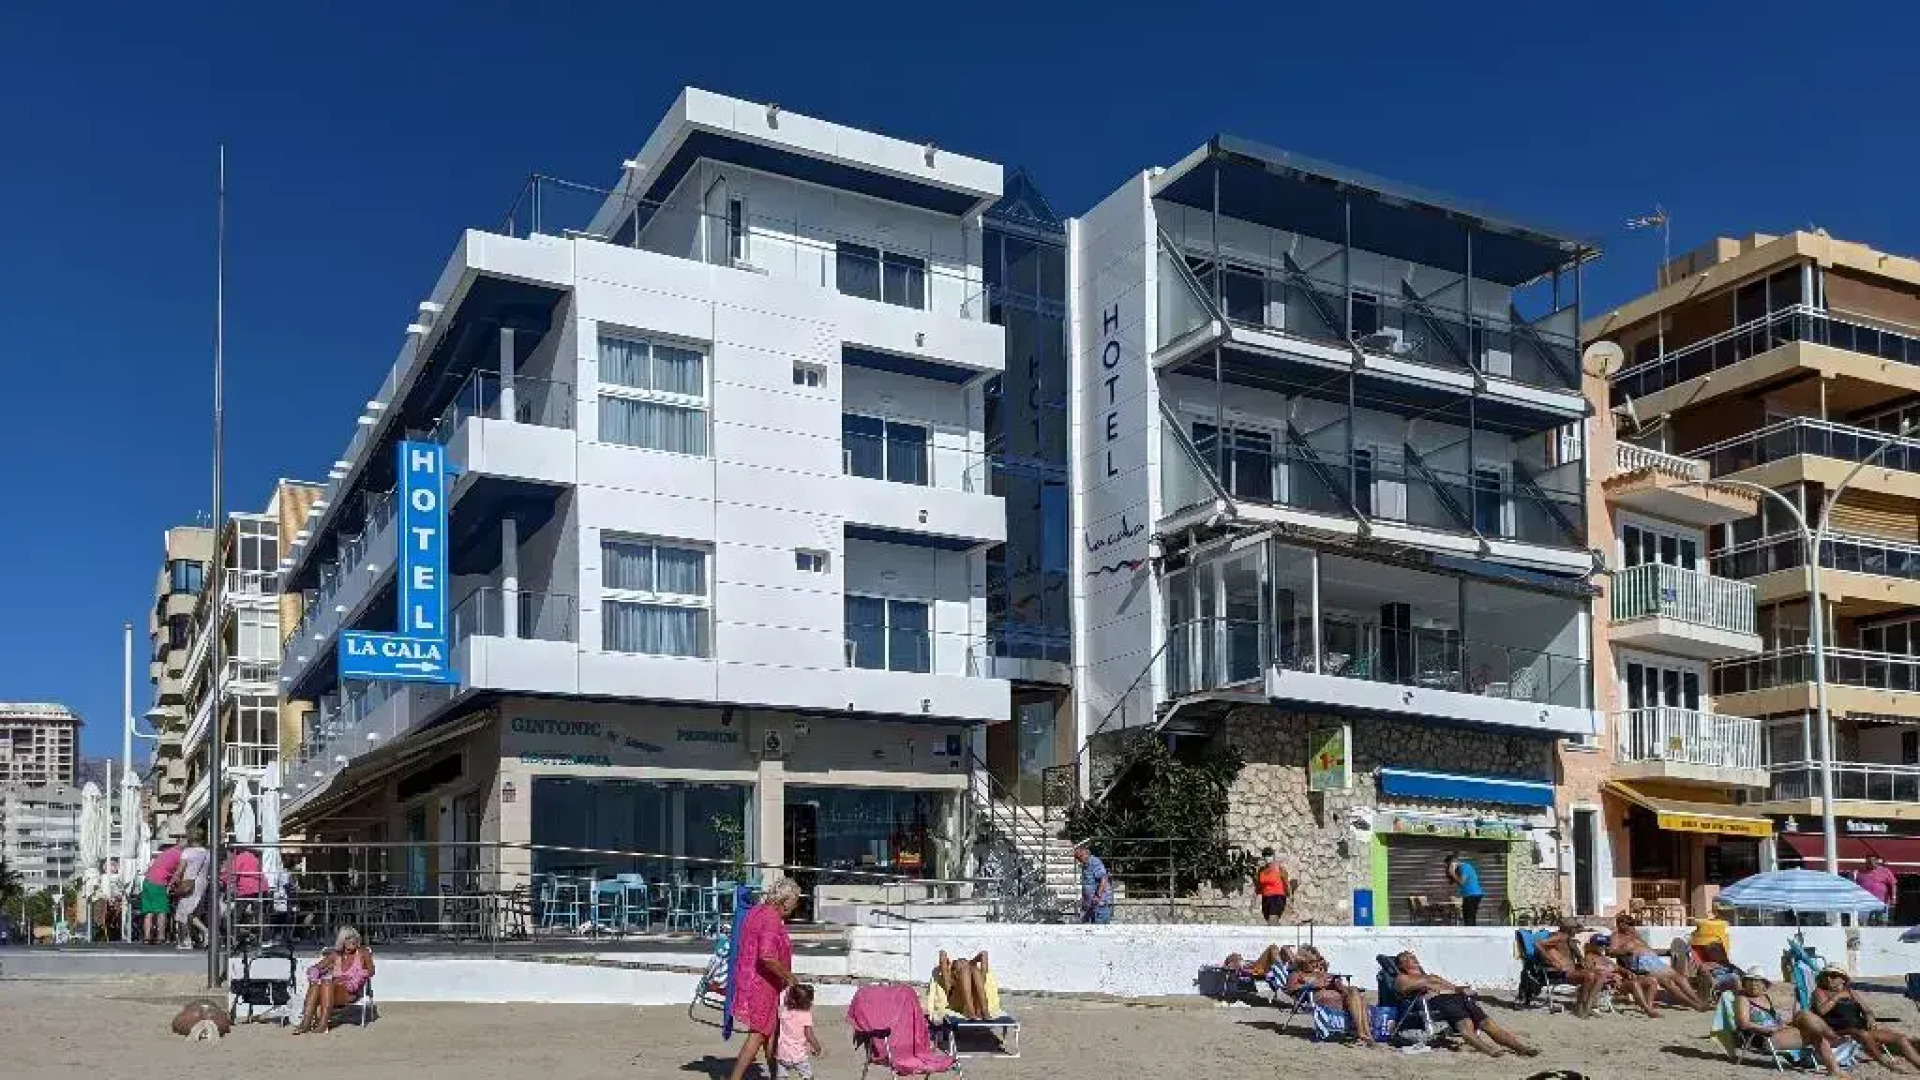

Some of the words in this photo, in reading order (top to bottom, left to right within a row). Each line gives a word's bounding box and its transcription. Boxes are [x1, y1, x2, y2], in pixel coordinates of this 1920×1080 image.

[1103, 303, 1120, 477] HOTEL
[411, 449, 436, 629] HOTEL
[346, 639, 378, 656] LA
[382, 642, 441, 660] CALA
[511, 717, 601, 737] GINTONIC
